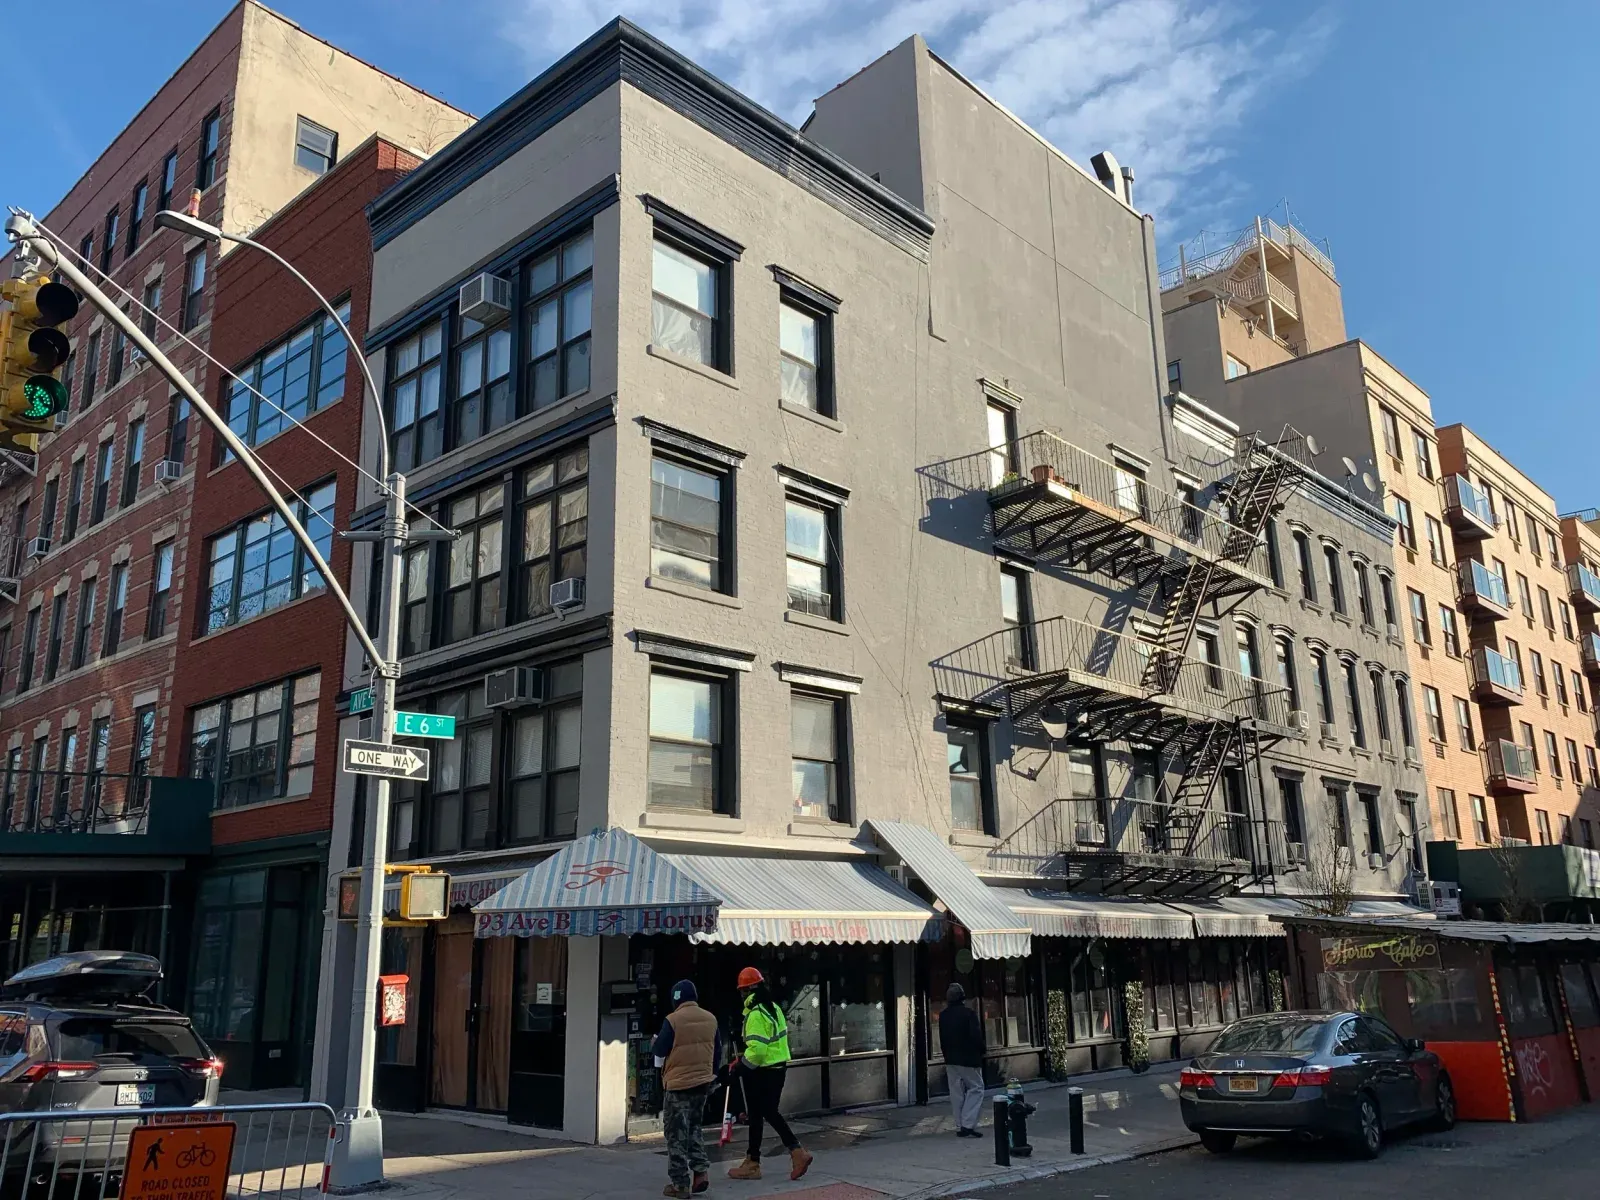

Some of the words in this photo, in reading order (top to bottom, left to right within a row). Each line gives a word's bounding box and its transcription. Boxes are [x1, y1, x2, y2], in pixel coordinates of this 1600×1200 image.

[353, 691, 368, 710] AVE
[404, 715, 414, 733] E
[419, 717, 430, 734] 6
[436, 718, 445, 727] ST
[357, 751, 382, 765] ONE
[392, 755, 417, 769] WAY
[478, 913, 504, 931] 93
[508, 913, 549, 931] Ave
[554, 913, 571, 930] B
[642, 910, 715, 929] Horus
[791, 920, 835, 938] Horus
[836, 920, 869, 938] Cafe
[1325, 938, 1376, 965] Horus
[1380, 938, 1436, 967] Cafe
[141, 1178, 169, 1192] ROAD
[172, 1175, 210, 1189] CLOSED
